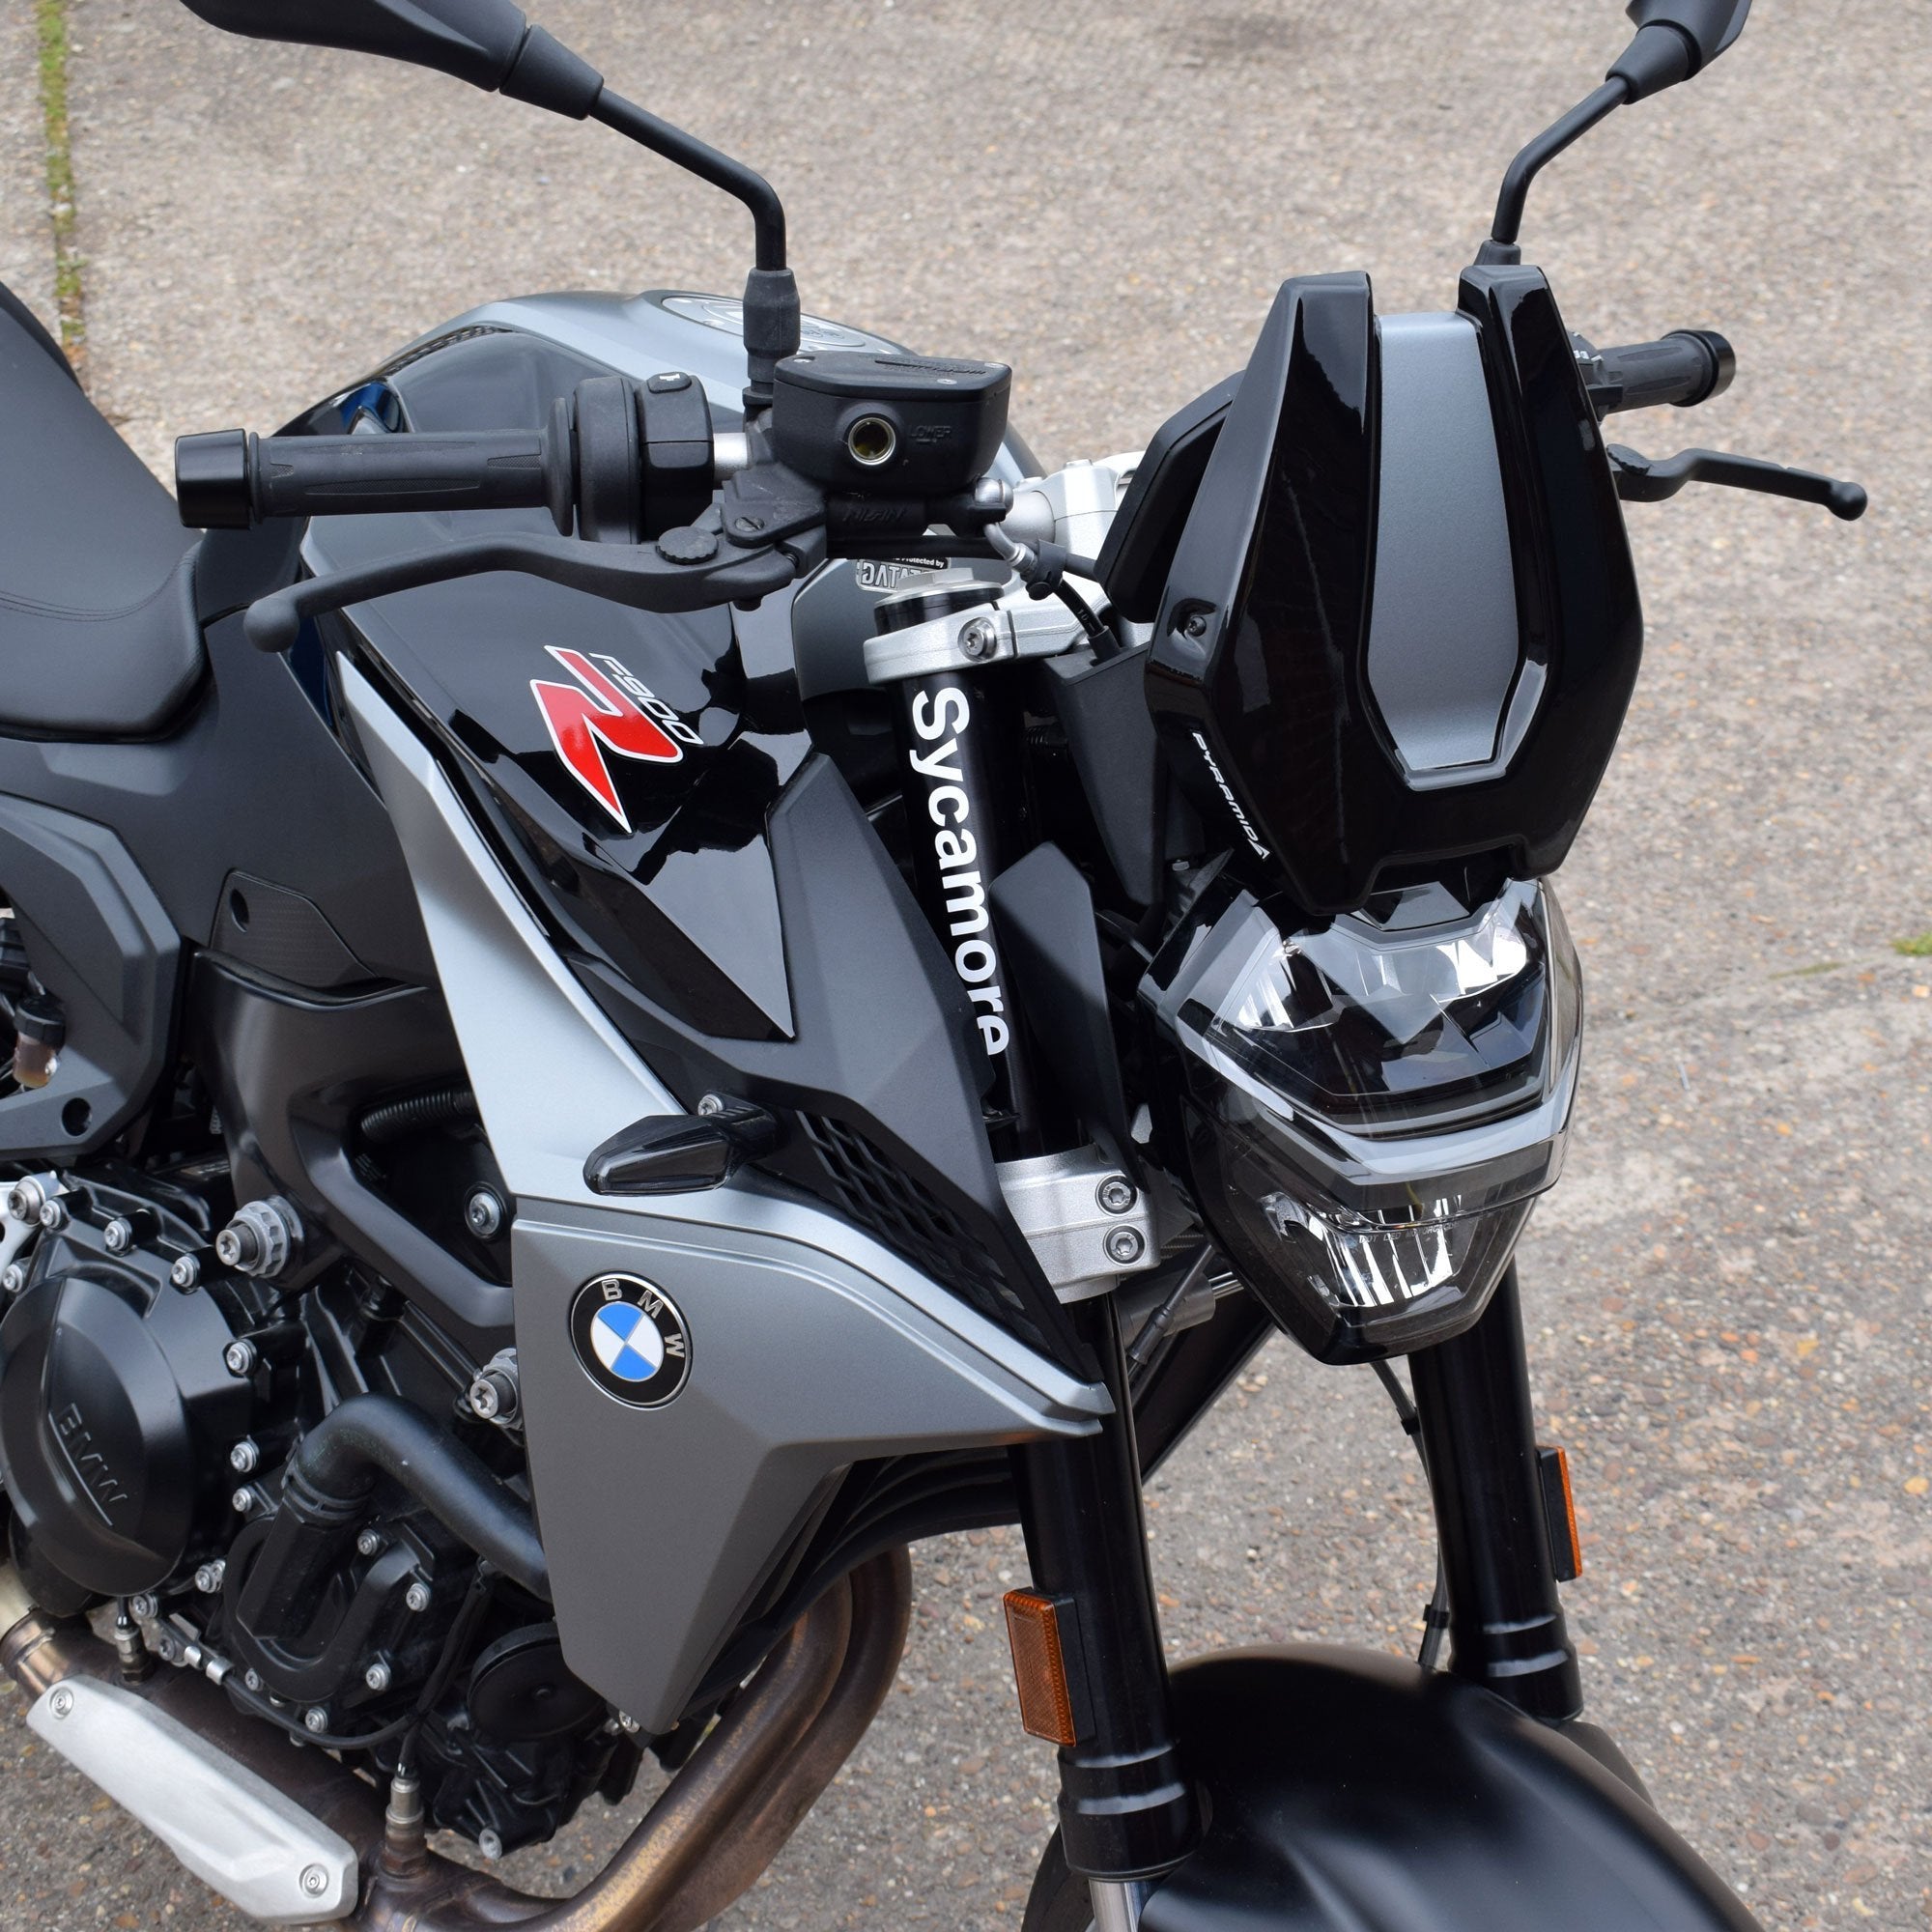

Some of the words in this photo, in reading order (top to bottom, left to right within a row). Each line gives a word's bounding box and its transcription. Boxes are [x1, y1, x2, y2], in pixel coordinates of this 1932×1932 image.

[935, 560, 945, 569] by
[588, 652, 704, 745] F900
[1192, 732, 1259, 841] PYRAMID
[909, 687, 1009, 1056] Sycamore
[601, 1278, 686, 1358] BMW
[54, 1403, 128, 1506] BMW
